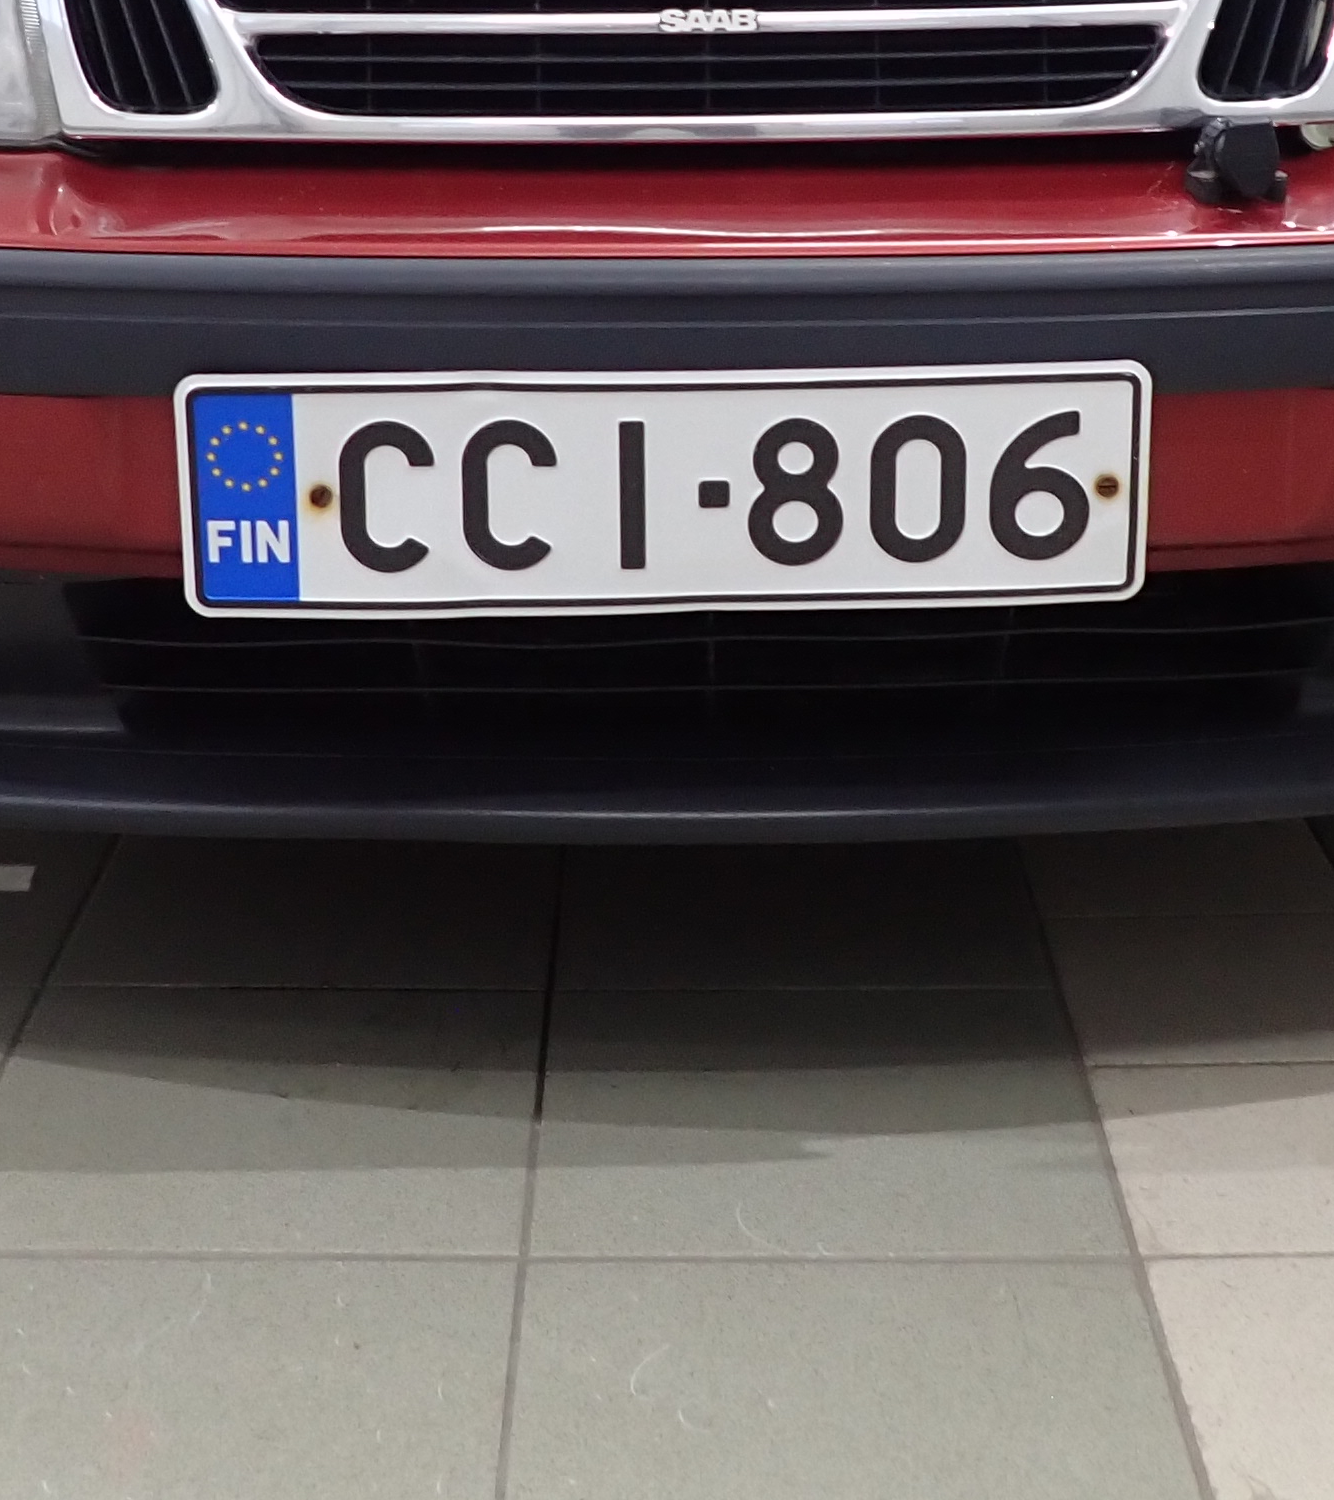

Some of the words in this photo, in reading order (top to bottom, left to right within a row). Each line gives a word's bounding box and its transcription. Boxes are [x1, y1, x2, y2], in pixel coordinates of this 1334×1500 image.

[659, 8, 758, 33] SAAB
[338, 410, 1090, 574] CCI-806
[206, 518, 292, 566] FIN
